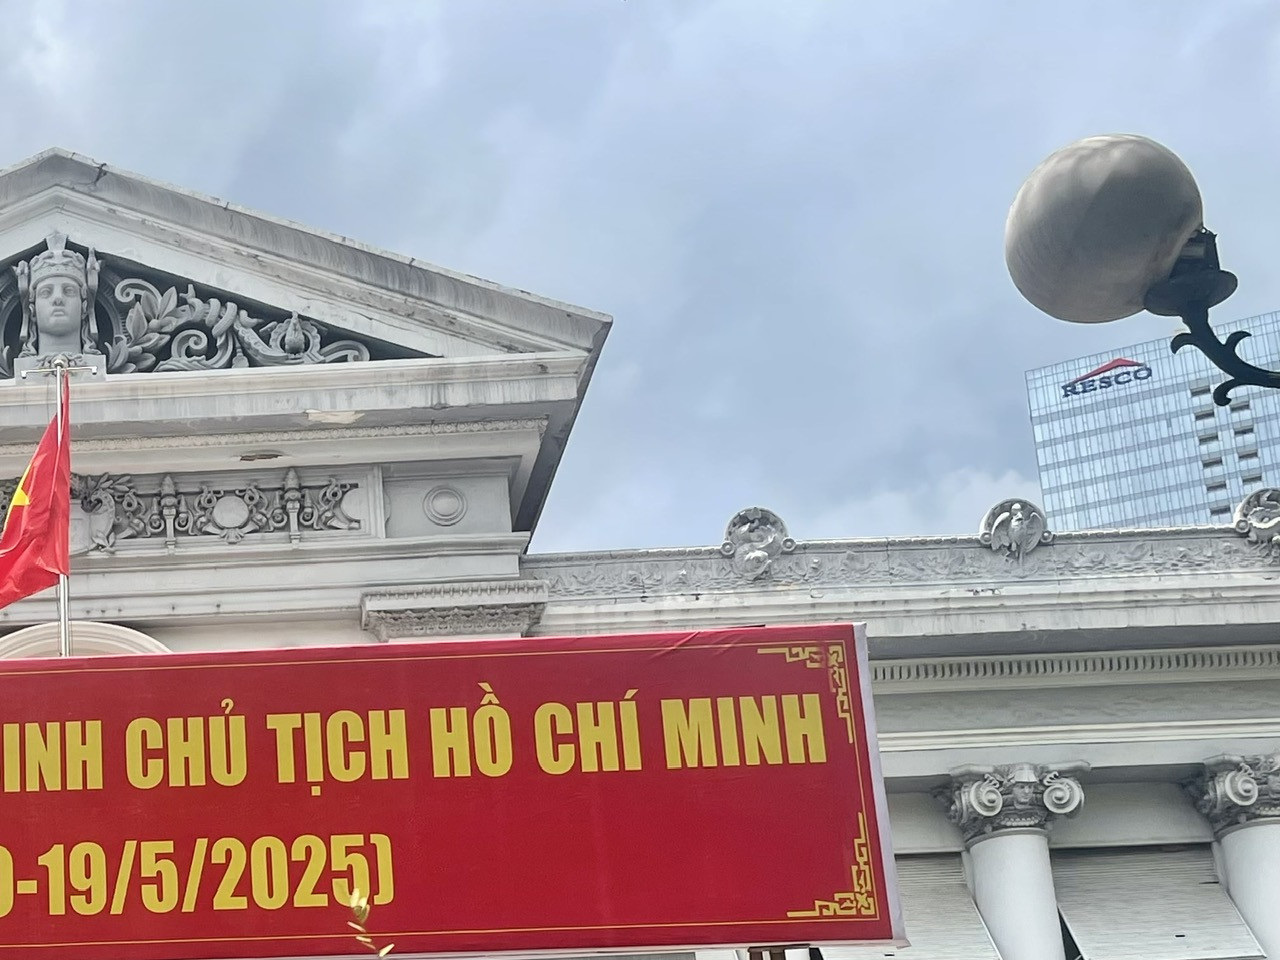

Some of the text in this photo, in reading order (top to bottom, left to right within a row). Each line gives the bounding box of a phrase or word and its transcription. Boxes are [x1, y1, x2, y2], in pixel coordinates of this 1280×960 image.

[1061, 366, 1152, 398] RESCO
[125, 698, 248, 789] CHỦ
[266, 709, 410, 796] TỊCH
[429, 682, 513, 778] HỒ
[534, 689, 642, 775] CHÍ
[661, 693, 827, 769] MINH
